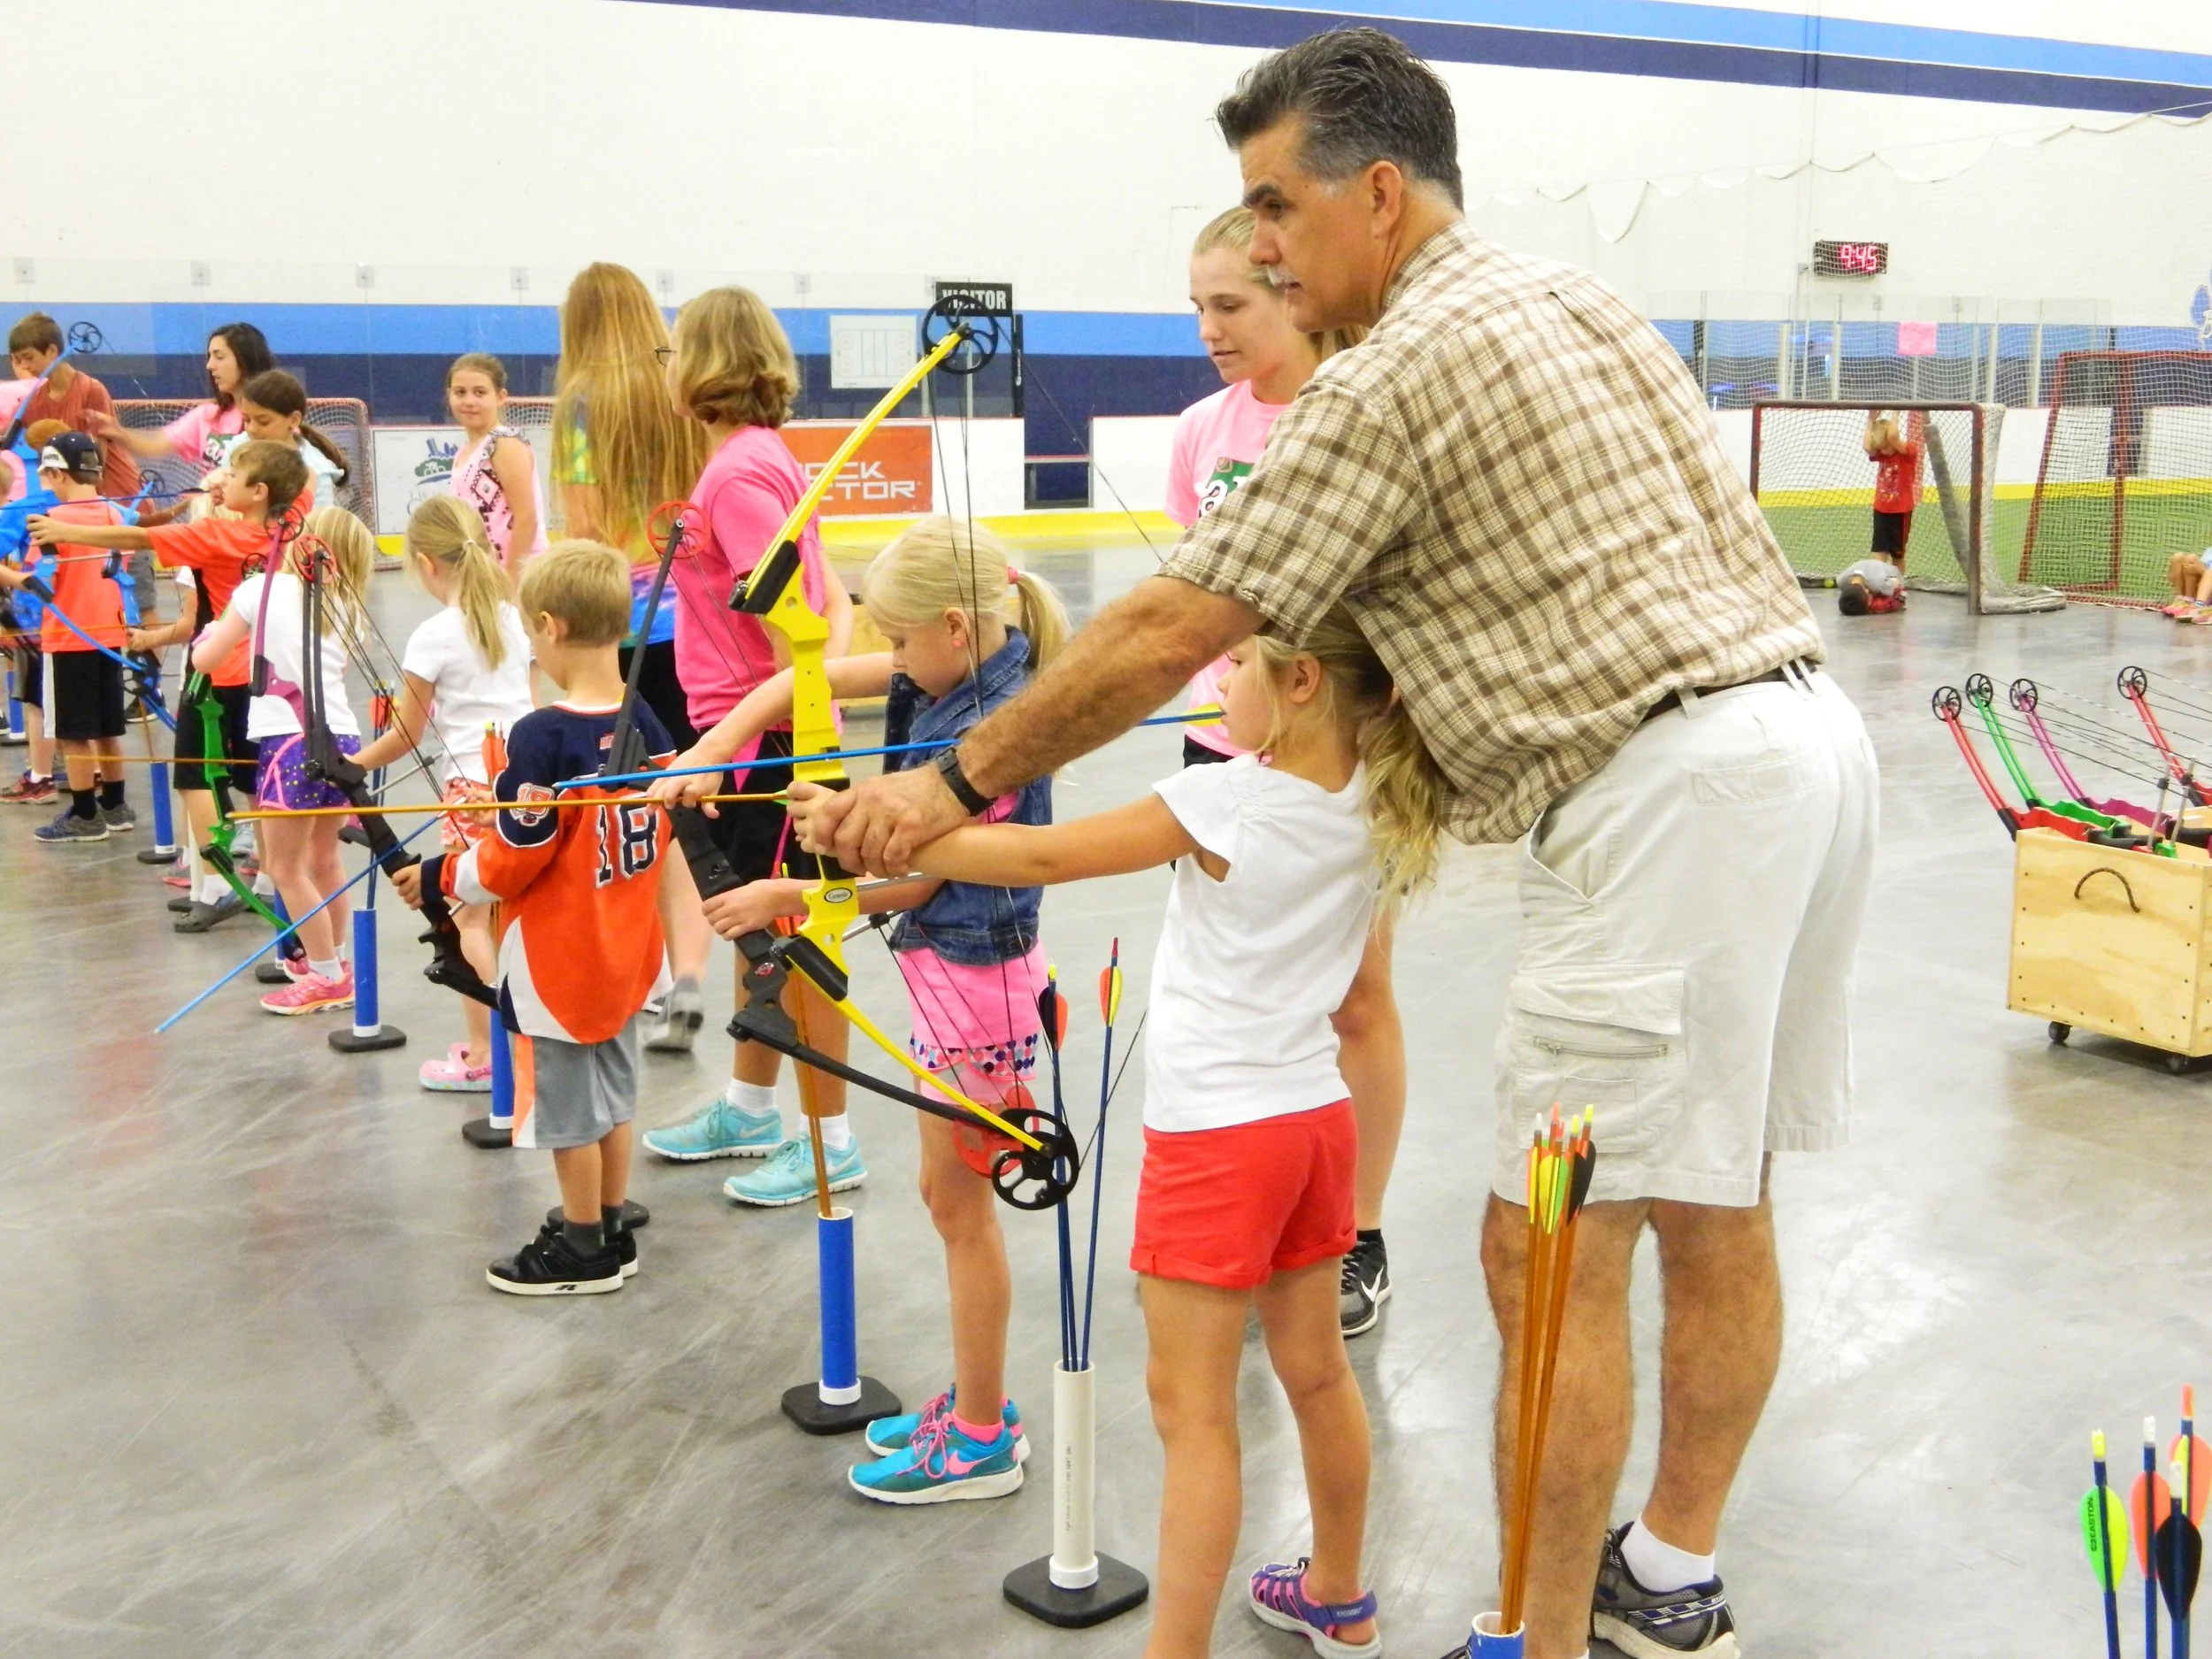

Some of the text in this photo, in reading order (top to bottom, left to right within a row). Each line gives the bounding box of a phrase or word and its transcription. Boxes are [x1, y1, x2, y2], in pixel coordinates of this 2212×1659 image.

[1840, 244, 1878, 270] 9:45
[595, 791, 658, 888] 18
[2087, 1496, 2097, 1539] EASTON
